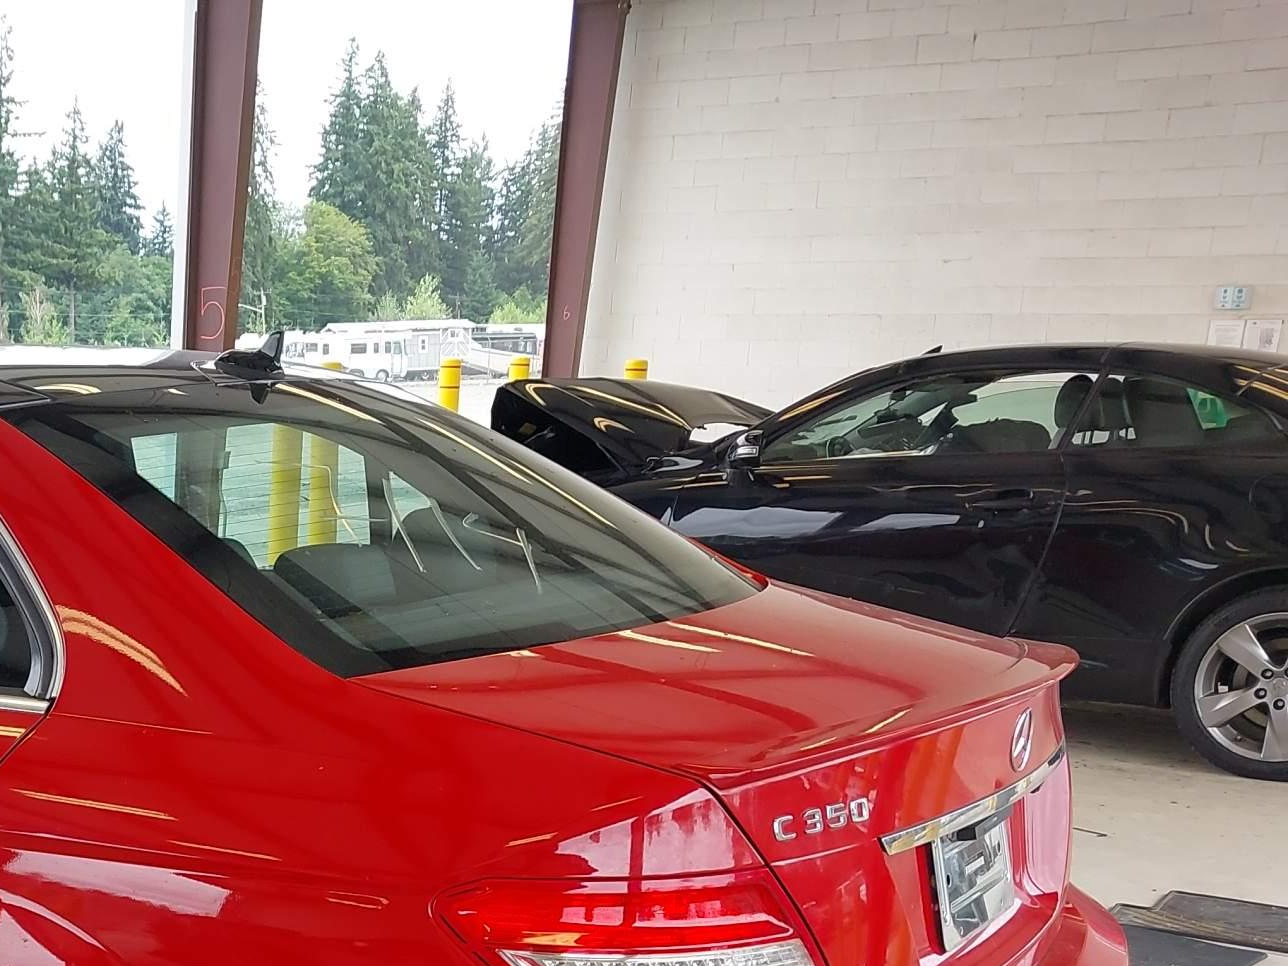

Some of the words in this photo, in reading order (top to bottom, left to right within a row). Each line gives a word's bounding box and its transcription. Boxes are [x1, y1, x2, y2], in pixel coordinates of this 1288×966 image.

[200, 286, 227, 340] 5
[563, 304, 570, 321] 6
[773, 815, 797, 842] C
[802, 797, 870, 834] 350
